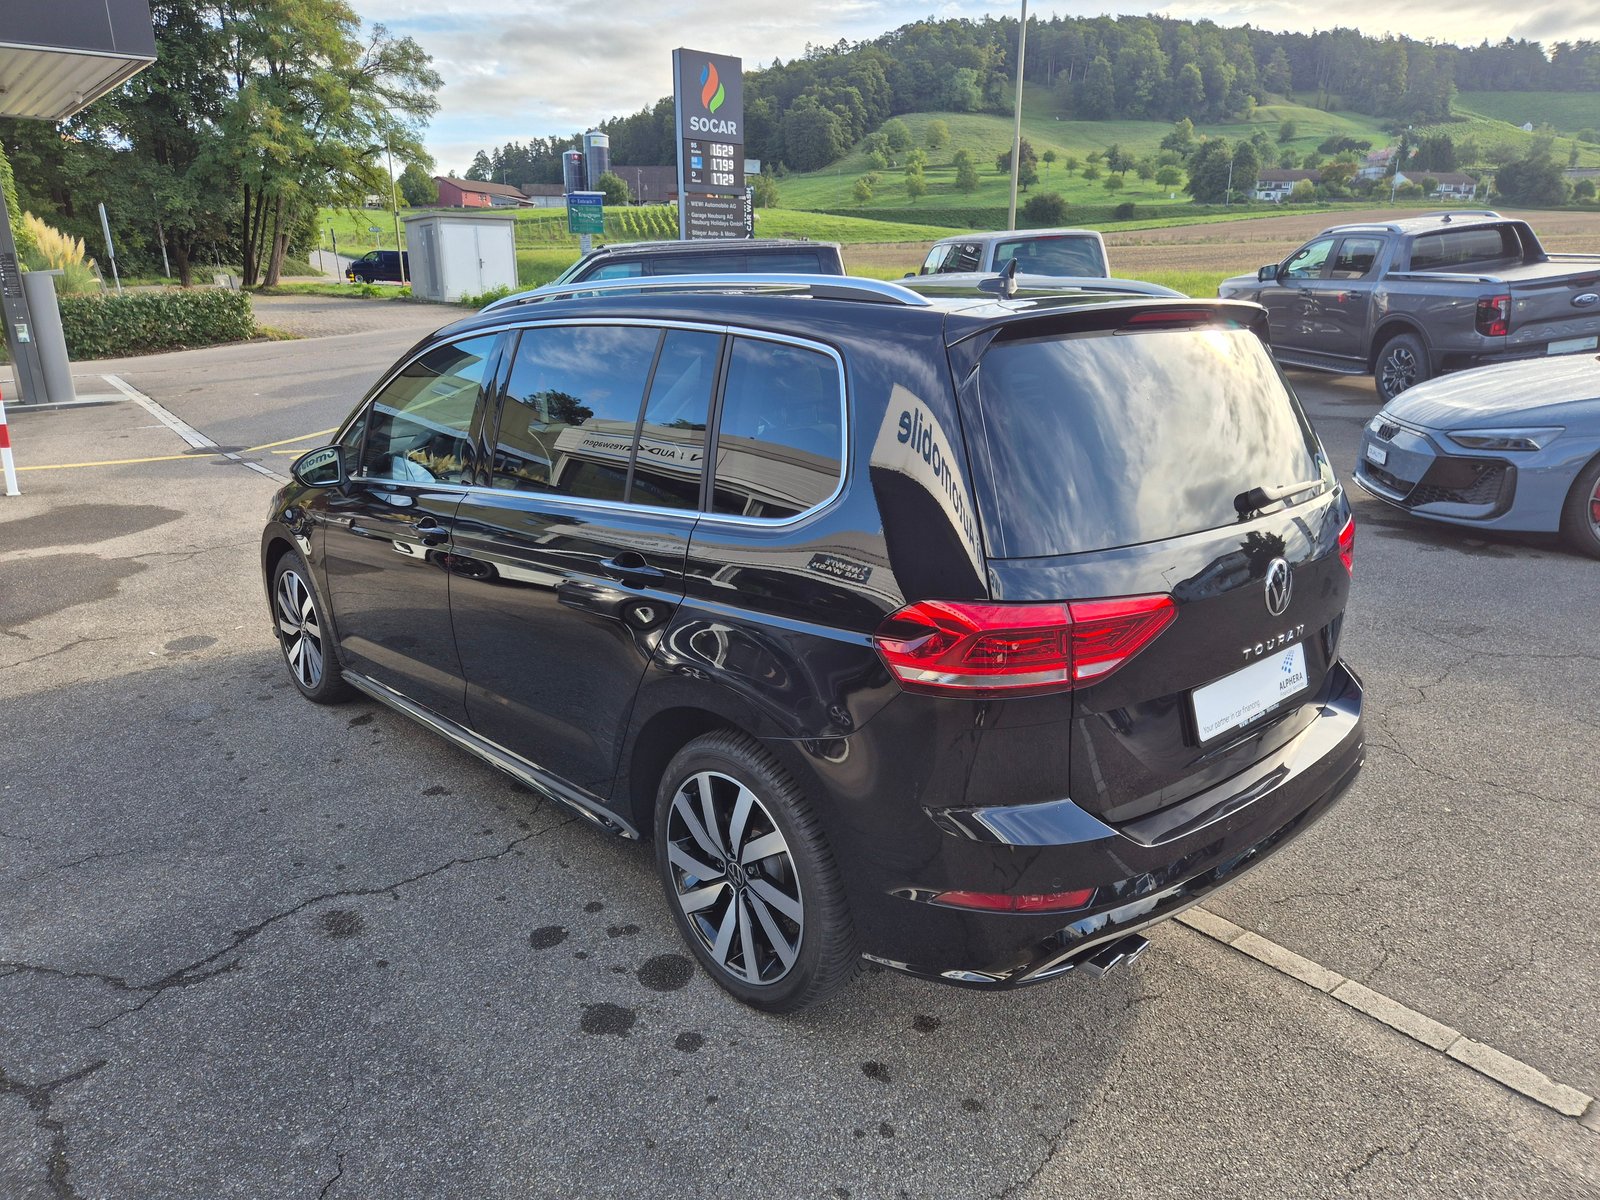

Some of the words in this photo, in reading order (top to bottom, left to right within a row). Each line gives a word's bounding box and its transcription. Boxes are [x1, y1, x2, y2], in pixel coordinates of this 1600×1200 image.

[690, 116, 737, 135] SOCAR
[1242, 624, 1305, 660] TOURAN
[1279, 671, 1303, 690] ALPHERA
